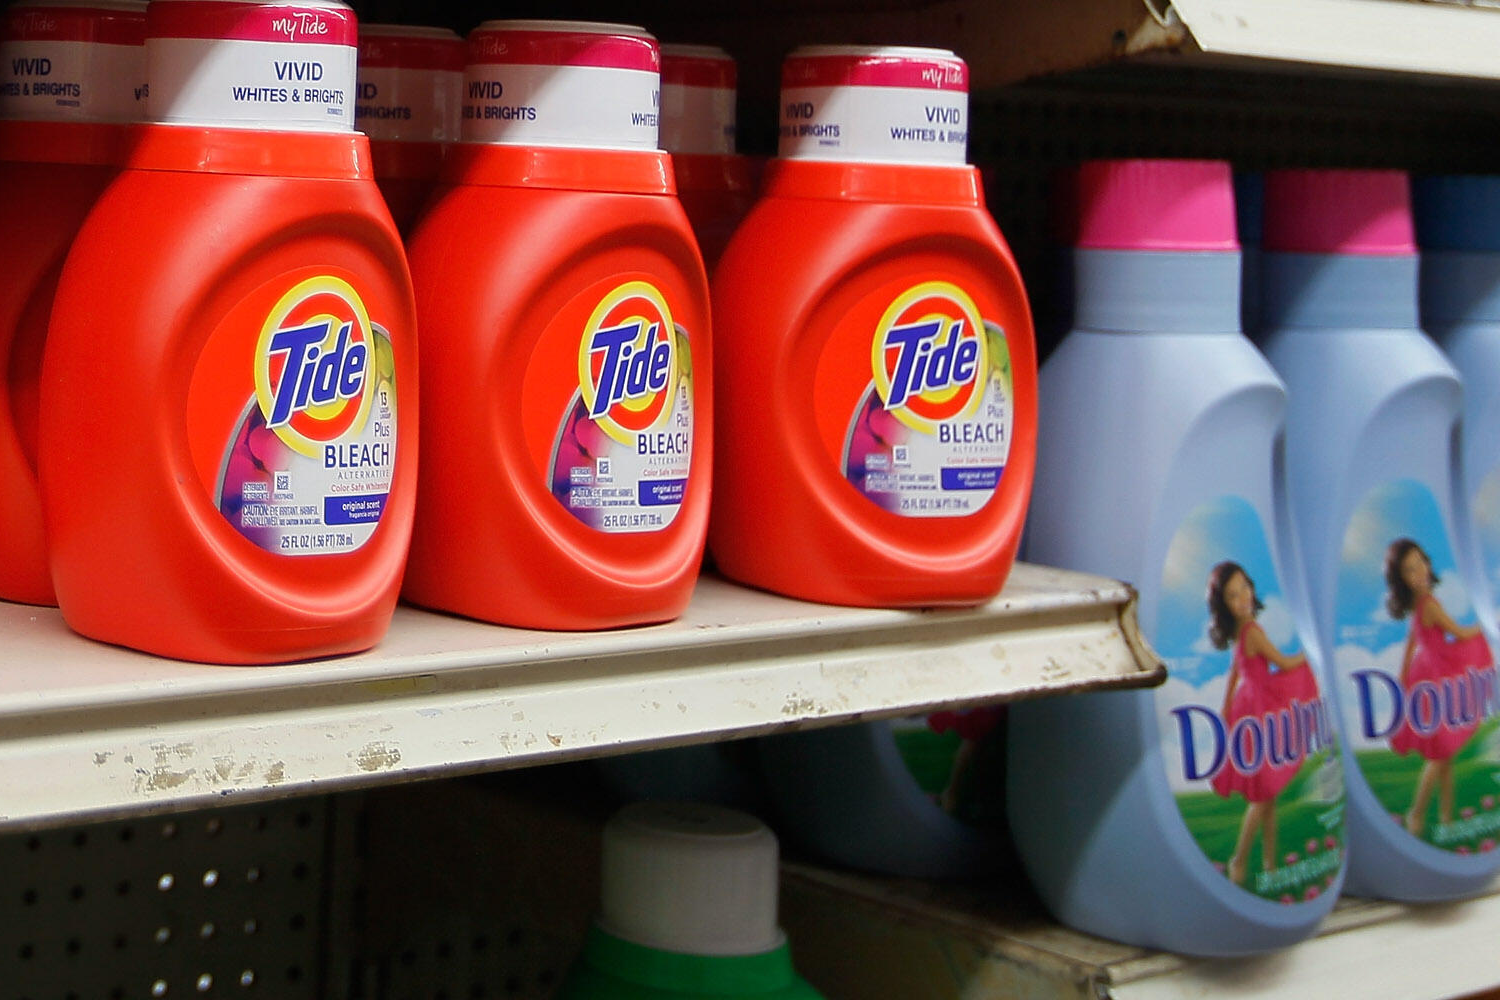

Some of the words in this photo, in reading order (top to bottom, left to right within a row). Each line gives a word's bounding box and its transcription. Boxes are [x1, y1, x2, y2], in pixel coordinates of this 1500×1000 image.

[13, 58, 51, 76] VIVID
[275, 61, 323, 81] VIVID
[33, 82, 80, 97] BRIGHTS
[233, 87, 288, 102] WHITES
[292, 89, 300, 102] &
[304, 88, 344, 105] BRIGHTS
[469, 81, 503, 98] VIVID
[485, 106, 536, 121] BRIGHTS
[925, 106, 960, 124] VIVID
[891, 127, 935, 142] WHITES
[588, 320, 671, 420] Tide
[884, 319, 979, 411] Tide
[265, 320, 368, 429] Tide
[374, 422, 390, 437] Plus
[939, 423, 1005, 443] BLEACH
[638, 432, 689, 455] BLEACH
[324, 443, 390, 468] BLEACH
[331, 483, 350, 493] Color
[351, 483, 364, 492] Safe
[342, 501, 365, 512] original
[366, 500, 380, 510] scent
[281, 535, 290, 548] 25
[291, 535, 300, 548] FL
[300, 534, 310, 548] OZ
[336, 533, 345, 547] 739
